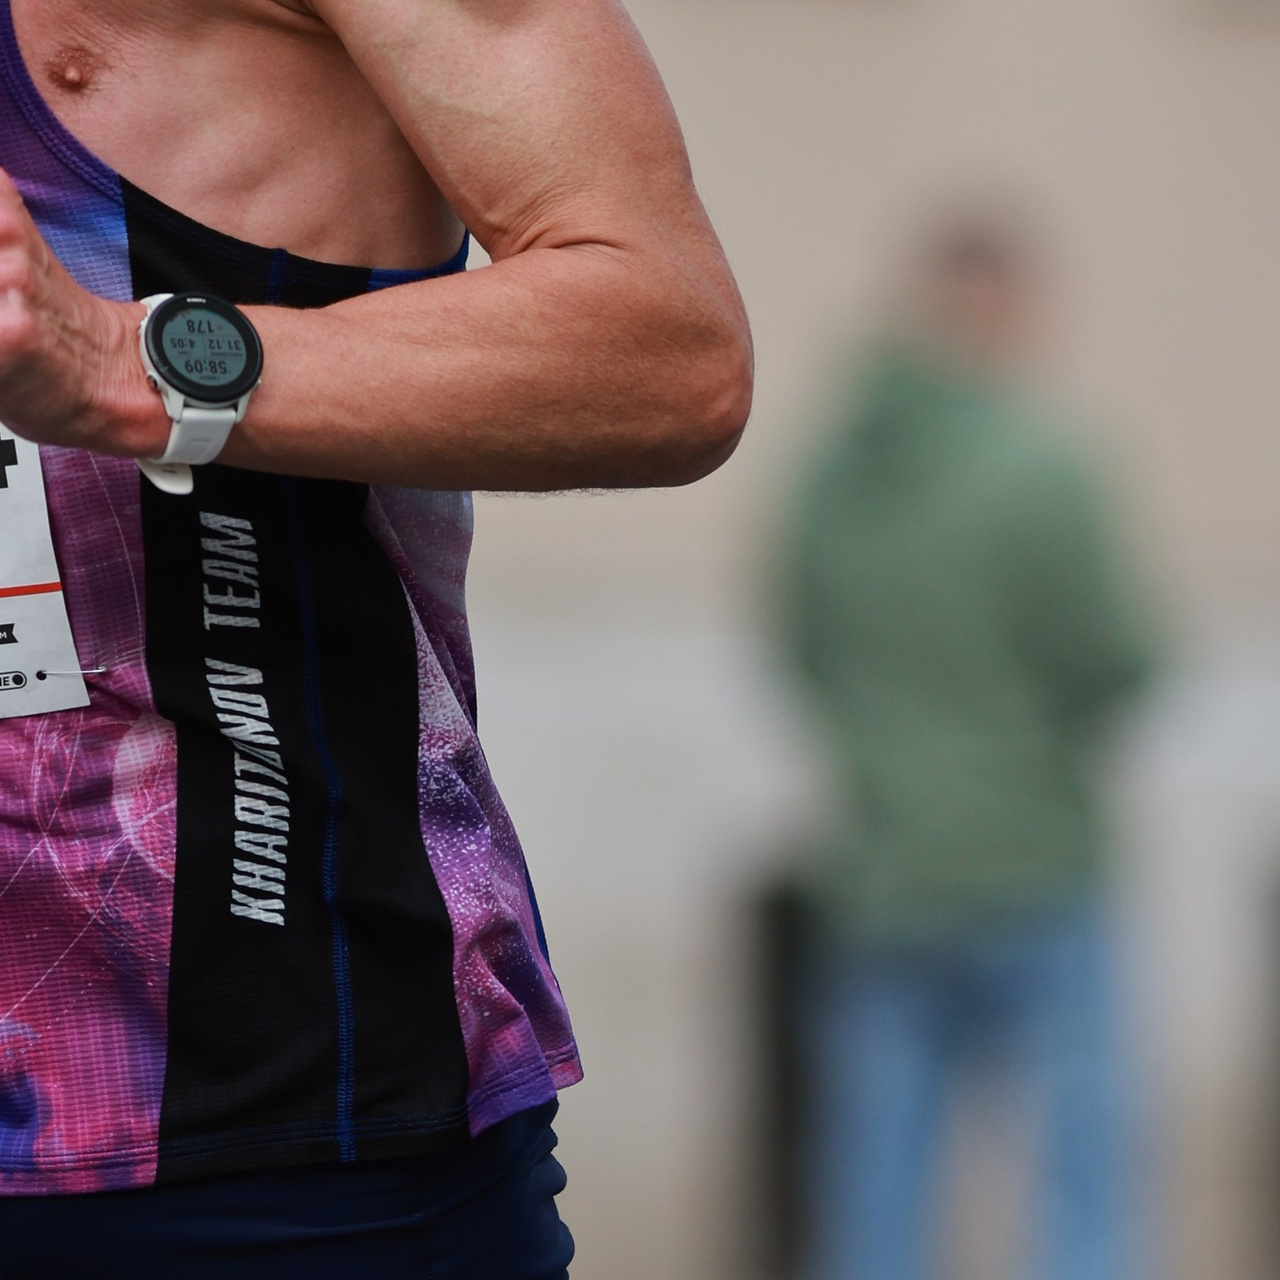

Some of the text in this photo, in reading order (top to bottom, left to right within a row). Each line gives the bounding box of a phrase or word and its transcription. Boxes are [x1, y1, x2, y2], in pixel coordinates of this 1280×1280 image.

[186, 319, 214, 334] 178
[199, 511, 291, 926] KHARITONOV TEAM
